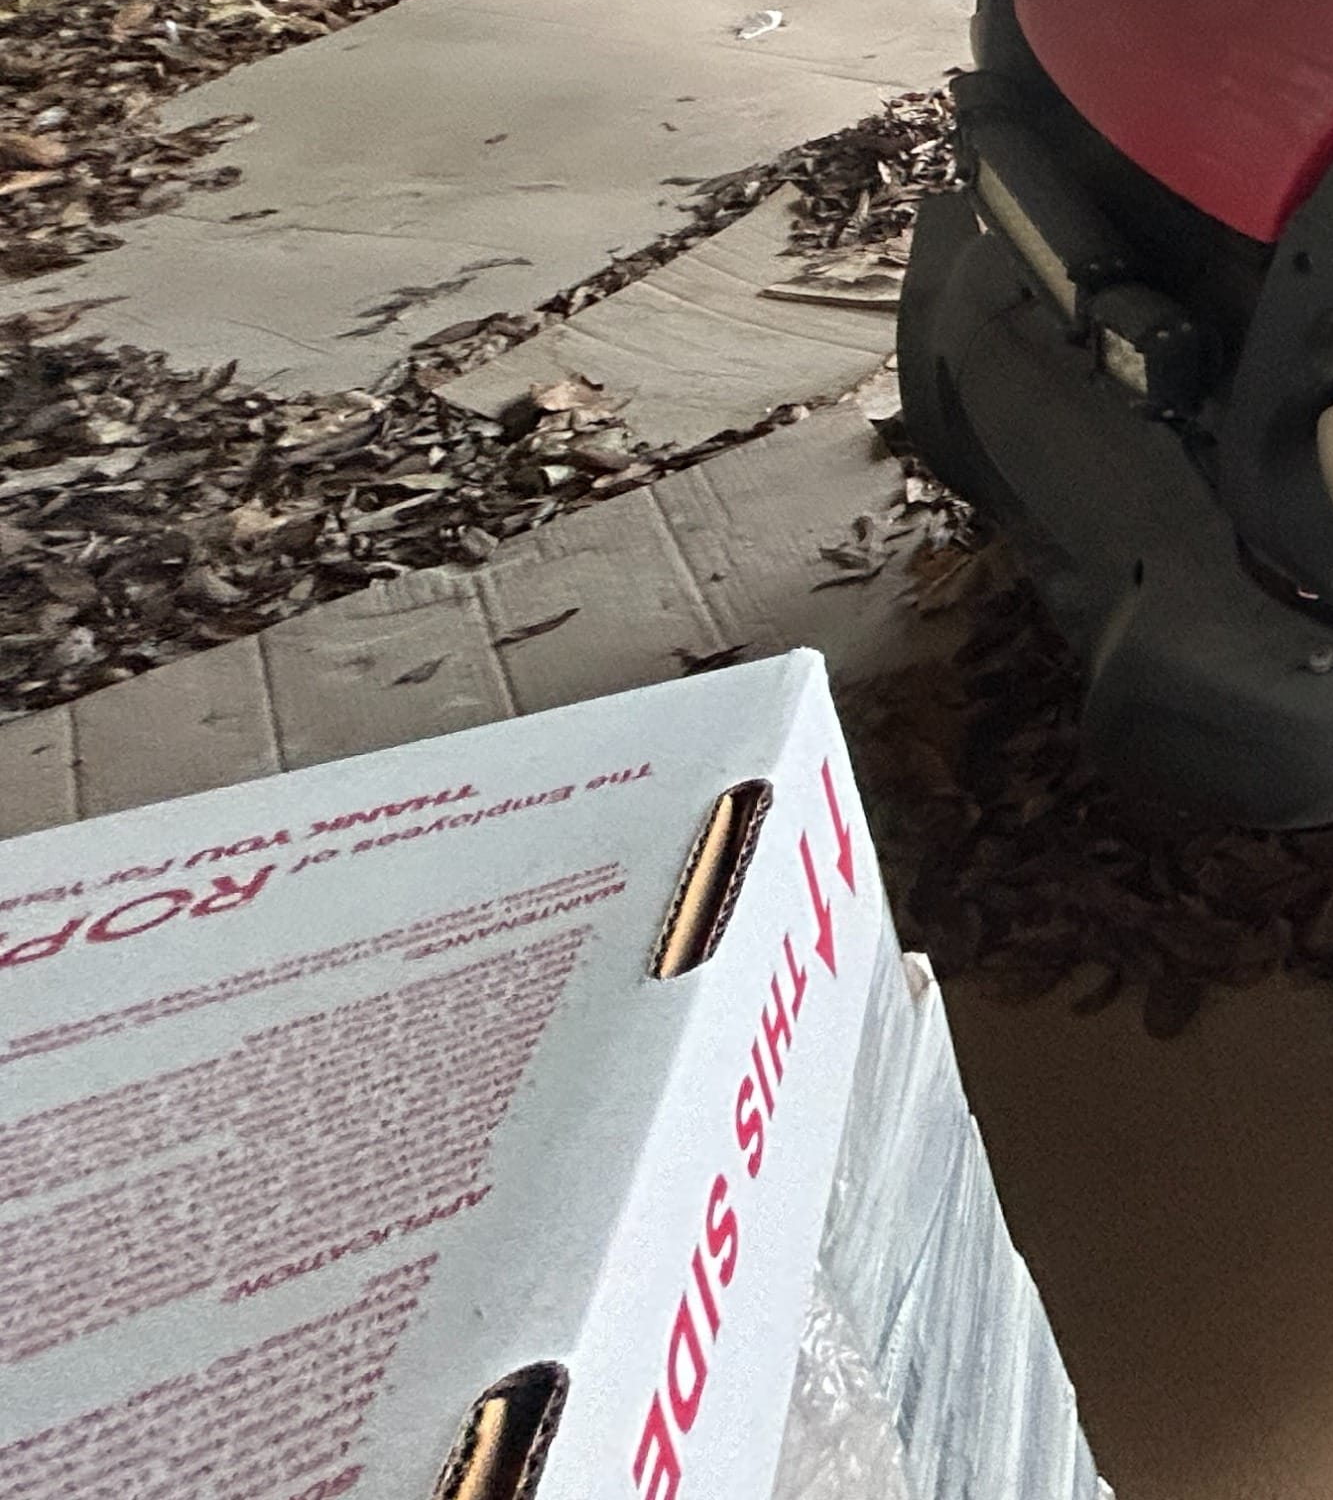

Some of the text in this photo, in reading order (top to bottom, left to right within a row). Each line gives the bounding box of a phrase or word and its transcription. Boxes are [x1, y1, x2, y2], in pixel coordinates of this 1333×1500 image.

[586, 761, 652, 790] The
[306, 784, 478, 839] THANK
[352, 784, 576, 853] Employees
[184, 829, 291, 868] YOU
[0, 864, 277, 968] ROP
[632, 932, 806, 1500] THIS SIDE
